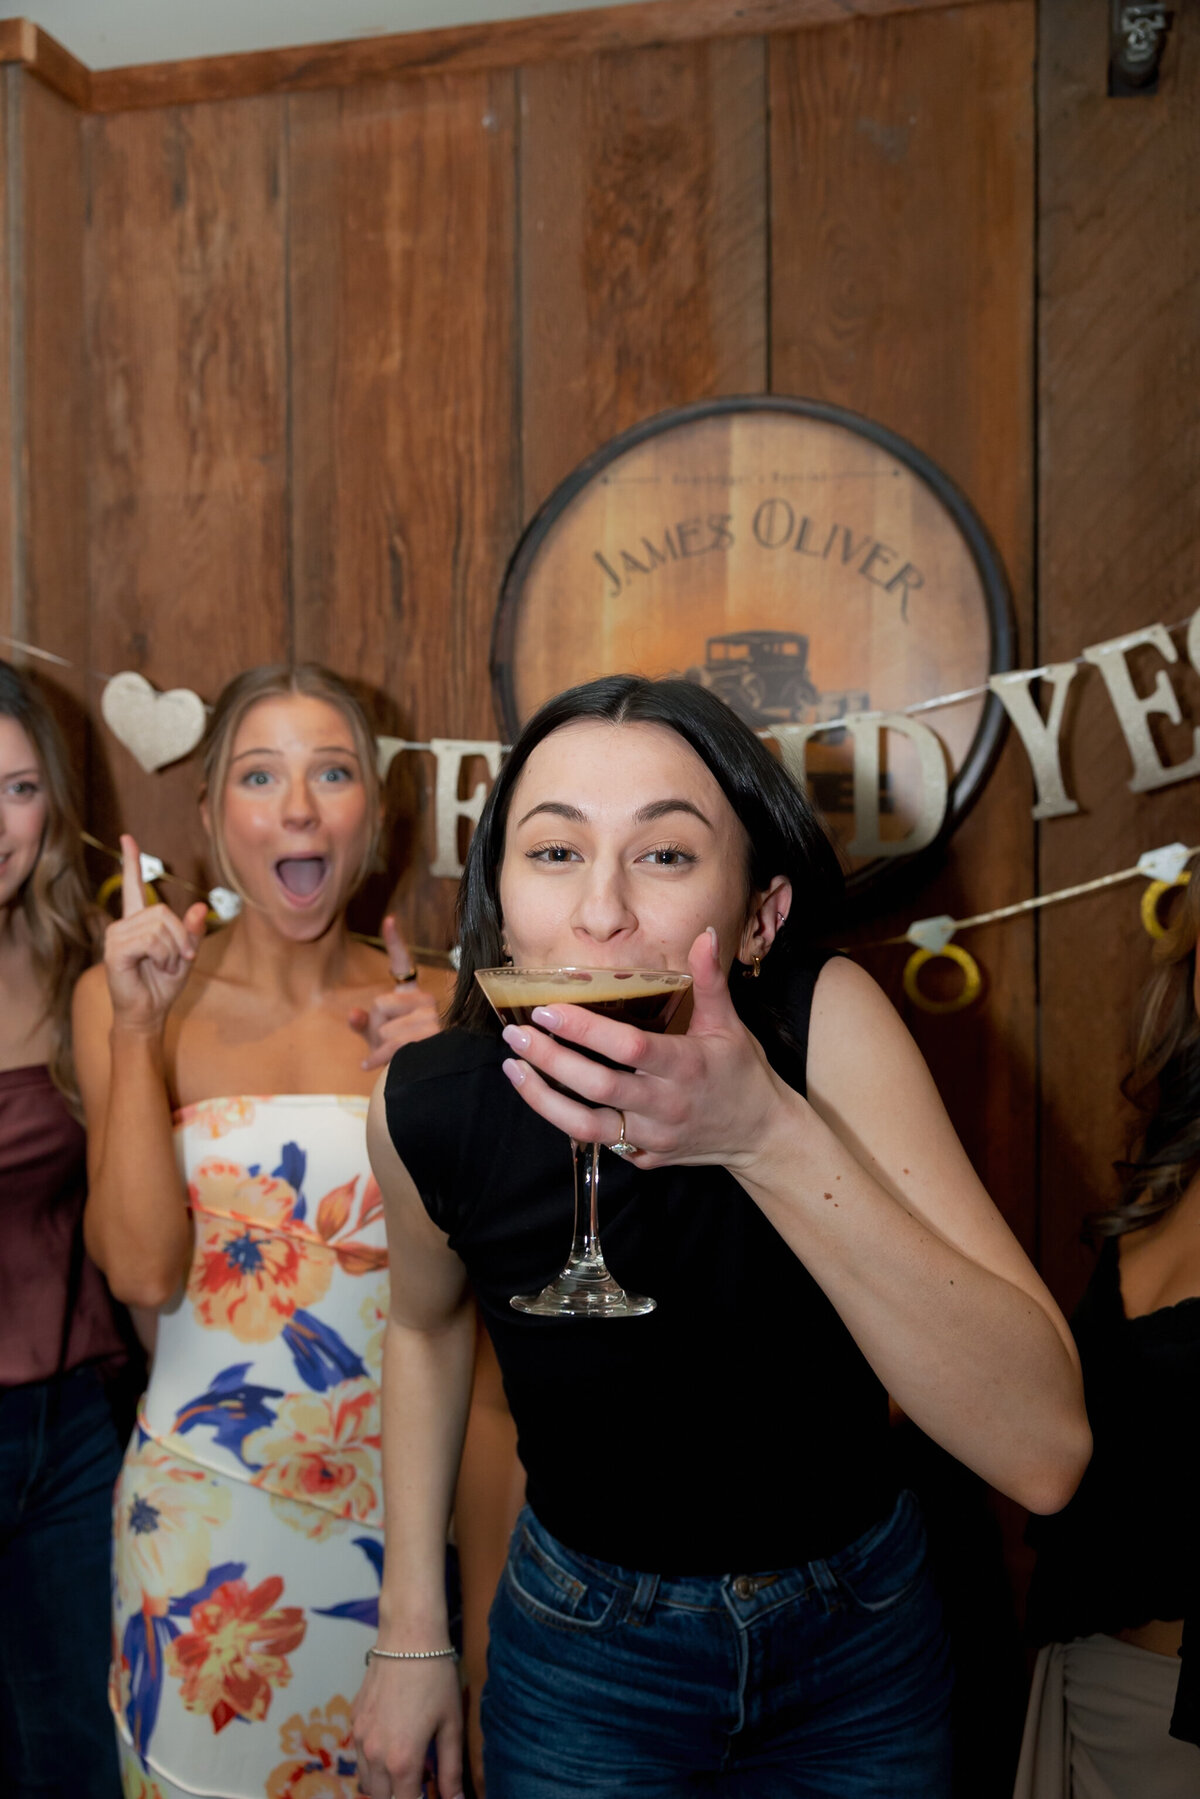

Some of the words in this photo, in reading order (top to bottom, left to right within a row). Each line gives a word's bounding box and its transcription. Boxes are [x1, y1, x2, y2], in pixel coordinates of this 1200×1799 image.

[594, 513, 735, 598] JAMES
[752, 498, 925, 625] OLIVER
[989, 607, 1200, 820] YE
